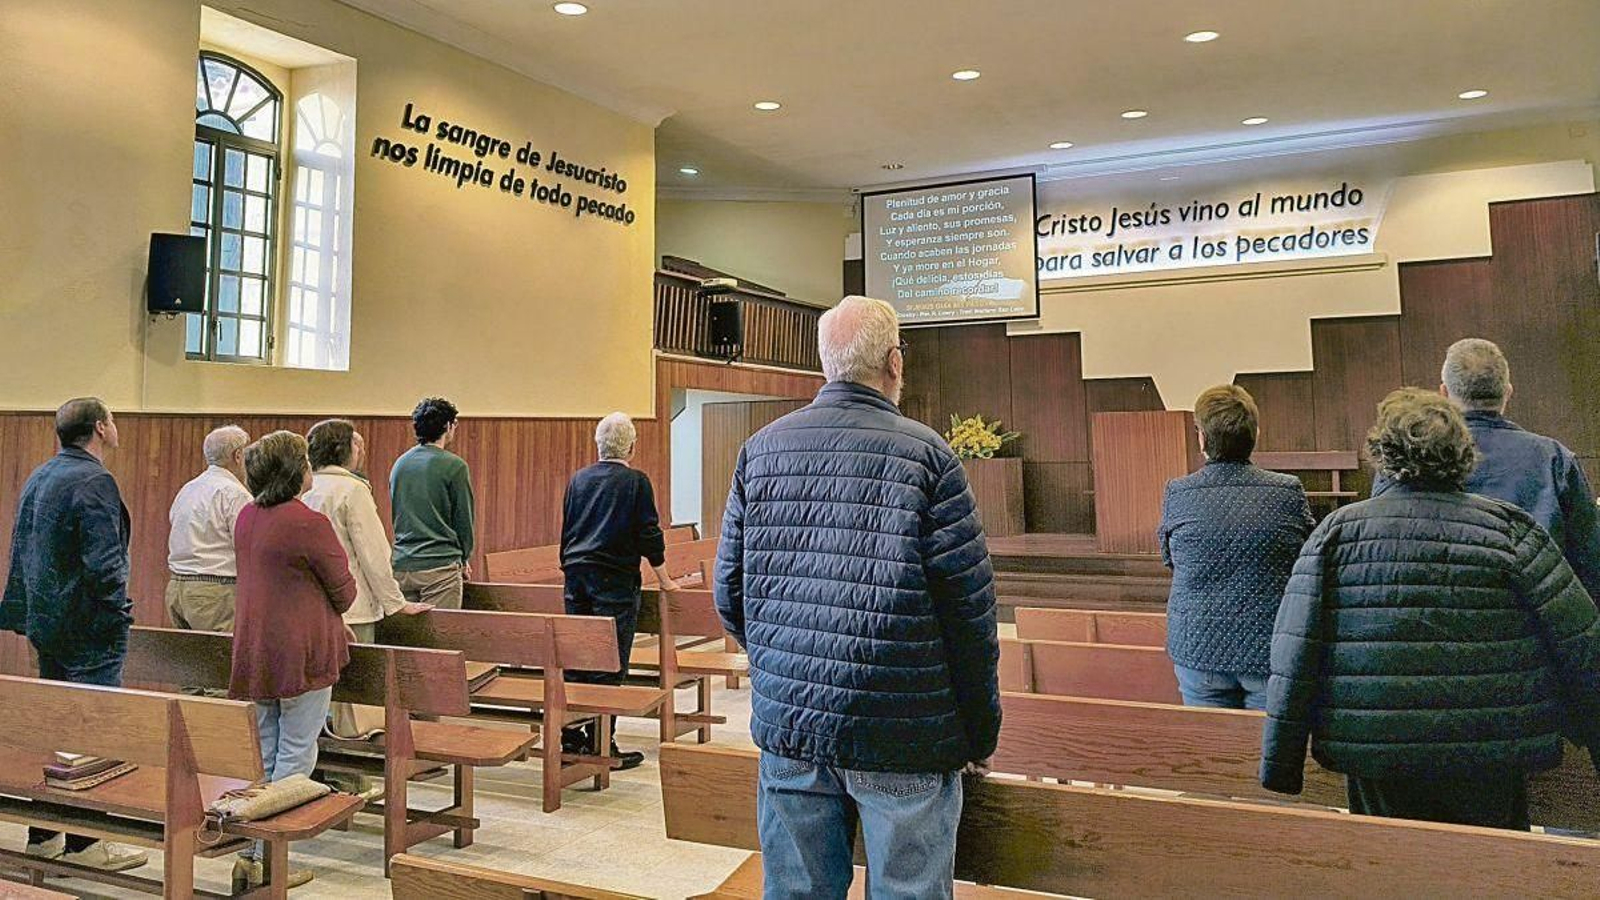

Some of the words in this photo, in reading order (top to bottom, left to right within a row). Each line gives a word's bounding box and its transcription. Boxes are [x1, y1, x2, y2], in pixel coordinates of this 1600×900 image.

[401, 103, 431, 134] La
[436, 121, 511, 158] sangre
[516, 141, 541, 167] de
[546, 152, 627, 193] Jesucristo
[371, 136, 419, 166] nos
[424, 143, 494, 188] limpia
[499, 169, 525, 194] de
[530, 178, 572, 208] todo
[576, 195, 635, 225] pecado
[886, 195, 925, 209] Plenitud
[927, 195, 939, 203] de
[941, 193, 966, 202] amor
[969, 191, 975, 200] y
[977, 186, 1010, 199] gracia
[890, 211, 914, 221] Cada
[916, 208, 931, 218] día
[933, 209, 945, 217] es
[948, 206, 960, 215] mi
[1036, 213, 1102, 238] Cristo
[1106, 202, 1171, 237] Jesús
[1179, 200, 1230, 223] vino
[1238, 193, 1260, 218] al
[1271, 182, 1363, 215] mundo
[880, 226, 897, 235] Luz
[899, 227, 905, 236] y
[943, 220, 961, 229] sus
[964, 213, 1017, 227] promesas,
[894, 236, 943, 248] esperanza
[944, 230, 985, 243] siempre
[1091, 244, 1160, 269] salvar
[1168, 241, 1183, 261] a
[1193, 236, 1228, 259] los
[1236, 226, 1370, 262] pecadores
[880, 251, 917, 261] Cuando
[918, 248, 953, 259] acaben
[955, 246, 969, 255] las
[972, 241, 1017, 255] jornadas
[893, 264, 901, 273] Y
[902, 264, 914, 274] ya
[915, 263, 940, 272] more
[942, 261, 954, 270] en
[956, 259, 966, 268] el
[898, 290, 913, 299] Del
